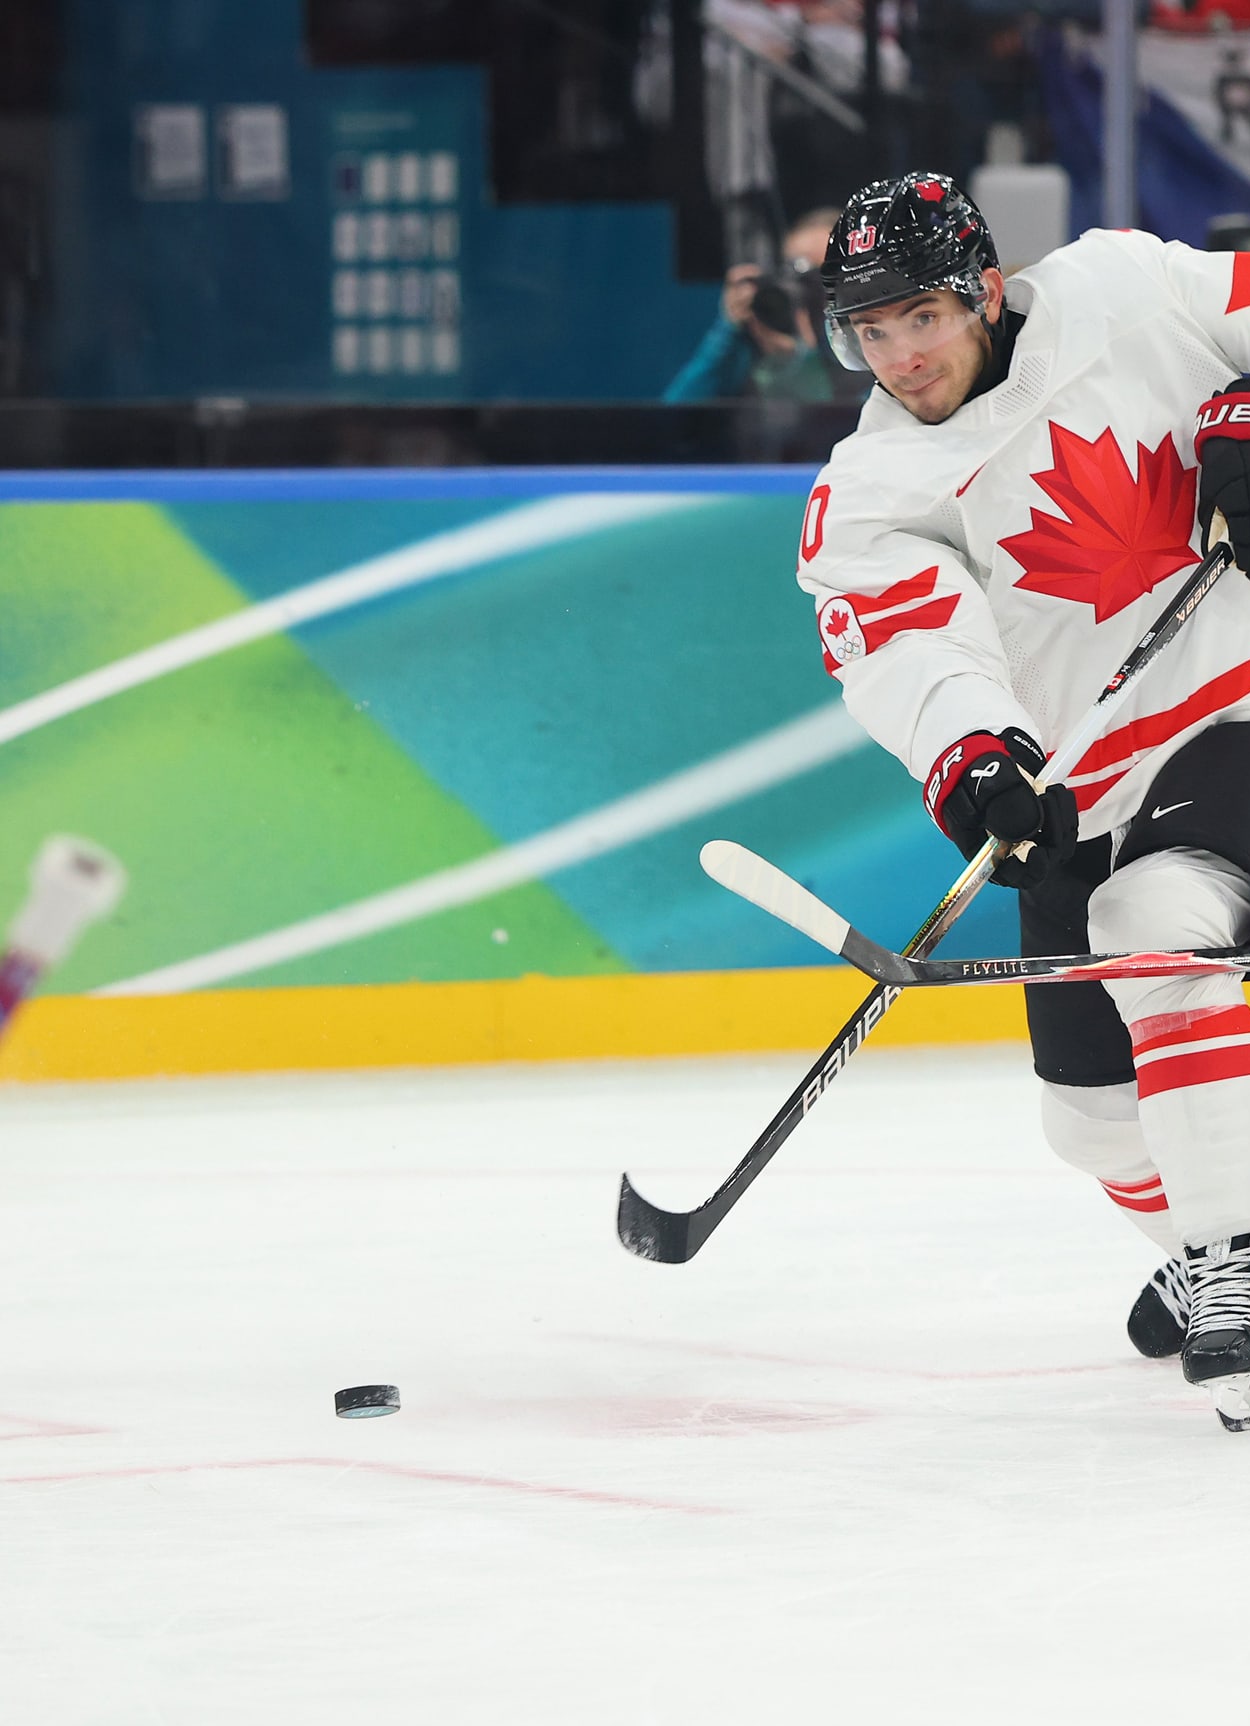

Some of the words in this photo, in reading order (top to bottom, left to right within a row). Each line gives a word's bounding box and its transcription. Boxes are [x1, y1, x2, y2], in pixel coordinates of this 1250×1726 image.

[846, 225, 877, 256] 10
[801, 484, 832, 563] 0
[1186, 557, 1226, 616] BAUER
[962, 962, 1029, 977] FLYLITE
